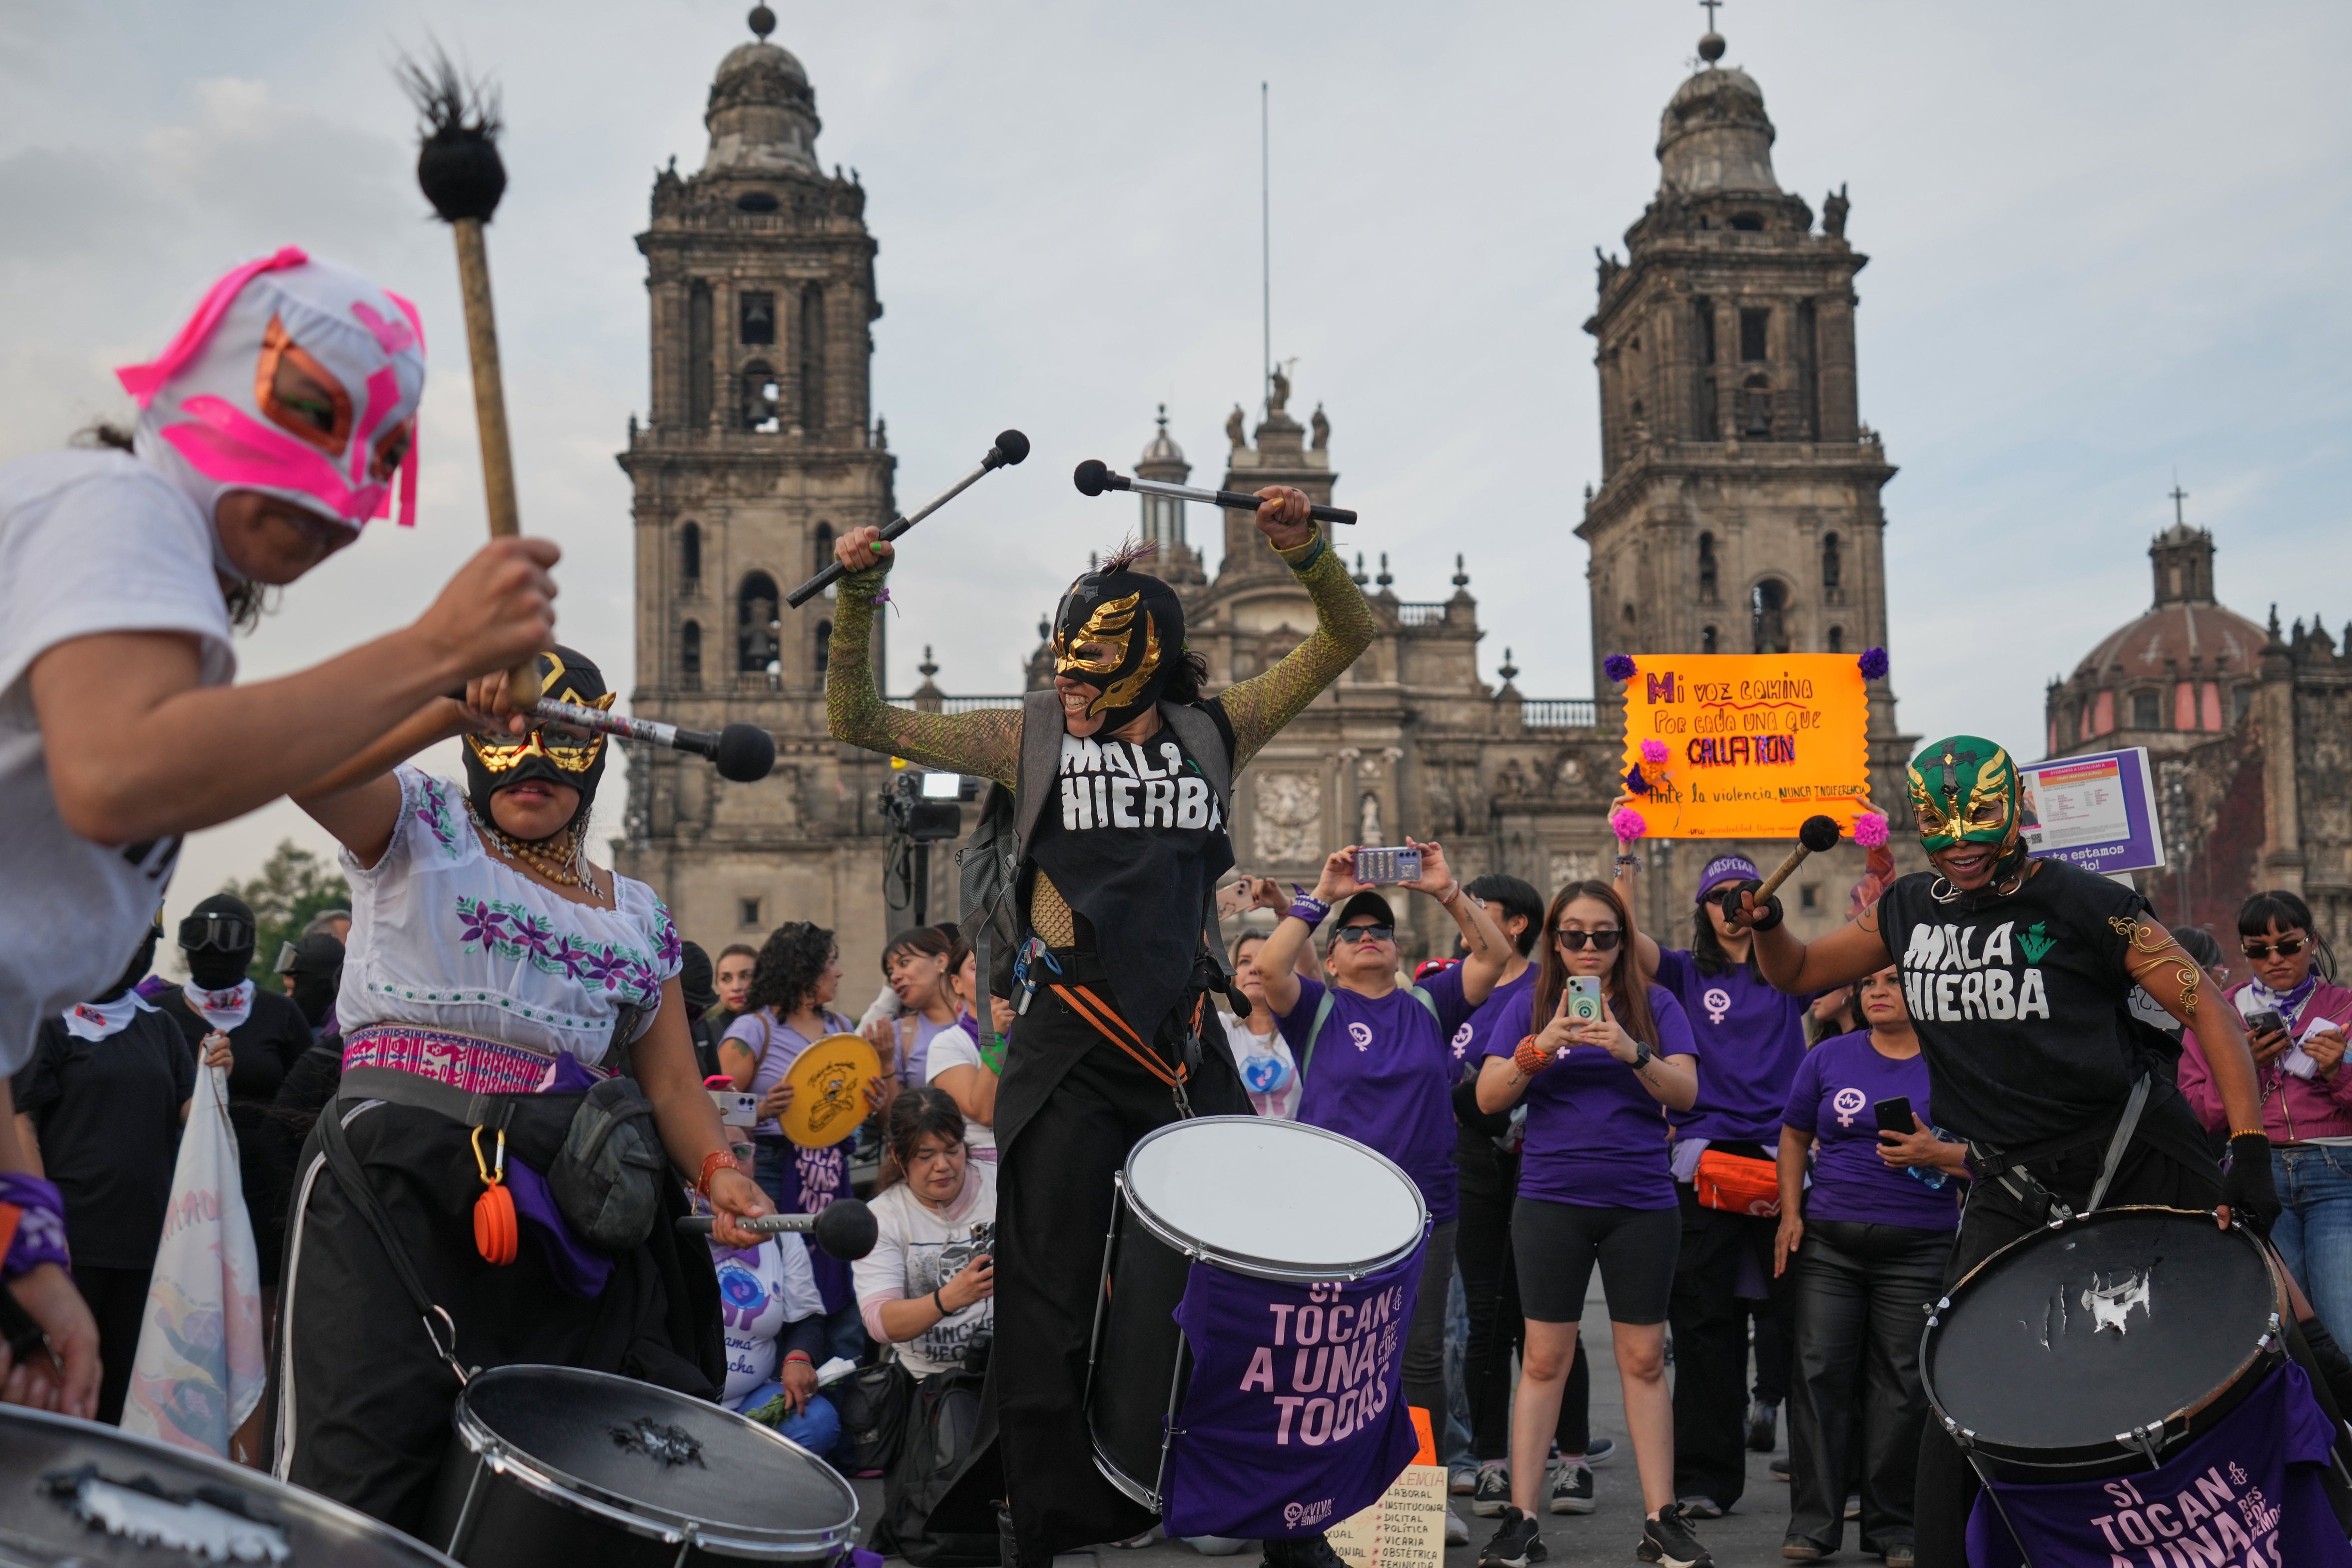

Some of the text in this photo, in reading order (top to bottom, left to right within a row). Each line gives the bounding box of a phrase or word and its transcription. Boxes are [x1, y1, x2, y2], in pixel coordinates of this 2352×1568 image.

[1647, 672, 1684, 705] Mi
[1692, 783, 1706, 803] la
[2052, 851, 2068, 861] te
[2071, 845, 2124, 860] estamos
[2080, 859, 2100, 870] do!
[1903, 920, 2015, 971] MALA
[1903, 968, 2050, 1021] HIERBA
[1270, 1285, 1395, 1346] TOCAN
[725, 1335, 757, 1351] amá
[728, 1355, 756, 1374] cha
[1239, 1332, 1377, 1393] A UNA
[1274, 1361, 1390, 1446] TODAS
[1394, 1471, 1445, 1487] LENCIA
[1387, 1488, 1433, 1499] LABORAL
[2103, 1479, 2145, 1508] SI
[2237, 1486, 2263, 1514] RES
[1385, 1500, 1447, 1513] INSTITUCIONAL
[2090, 1466, 2236, 1553] TOCAN
[1384, 1513, 1423, 1523] DIGITAL
[1326, 1530, 1355, 1539] XUAL
[1384, 1524, 1429, 1534] POLÍTICA
[1384, 1536, 1424, 1547] VICARIA
[1382, 1548, 1438, 1560] OBSTÉTRICA
